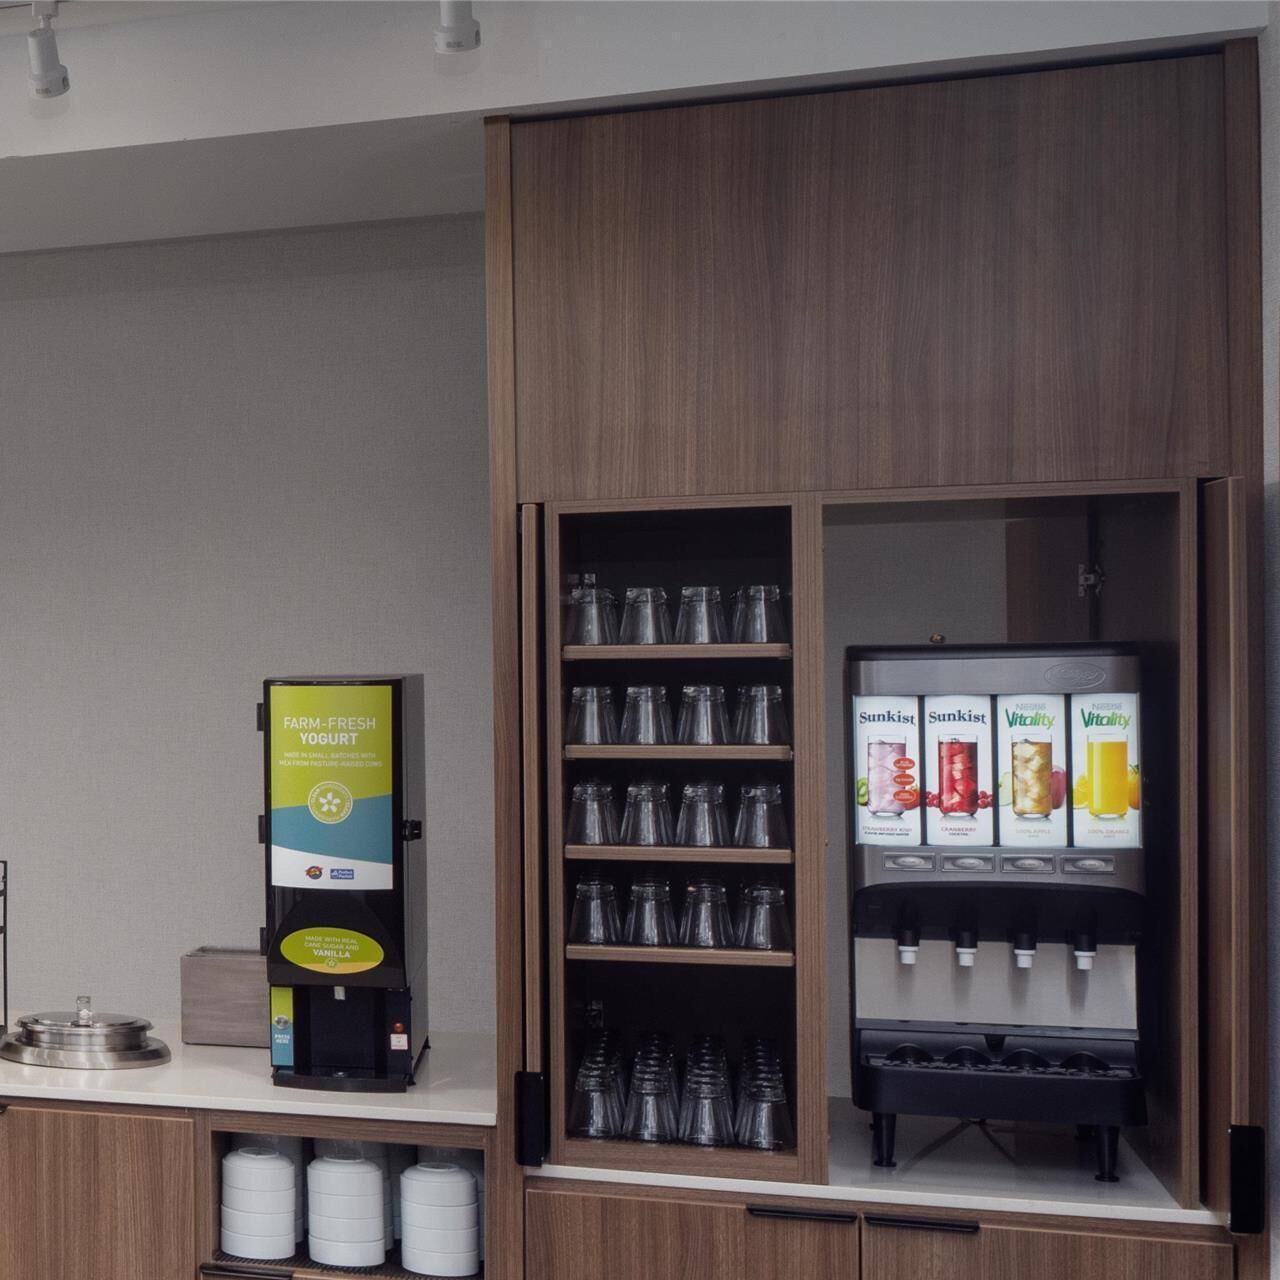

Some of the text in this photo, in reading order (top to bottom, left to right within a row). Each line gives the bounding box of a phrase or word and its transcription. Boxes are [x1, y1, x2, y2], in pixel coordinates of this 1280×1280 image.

[283, 716, 376, 729] FARM-FRESH
[860, 711, 916, 727] Sunkist
[928, 710, 988, 726] Sunkist
[1005, 708, 1056, 730] Vitality
[1081, 708, 1132, 730] Vitality
[300, 732, 358, 745] YOGURT
[313, 949, 351, 958] VANILLA
